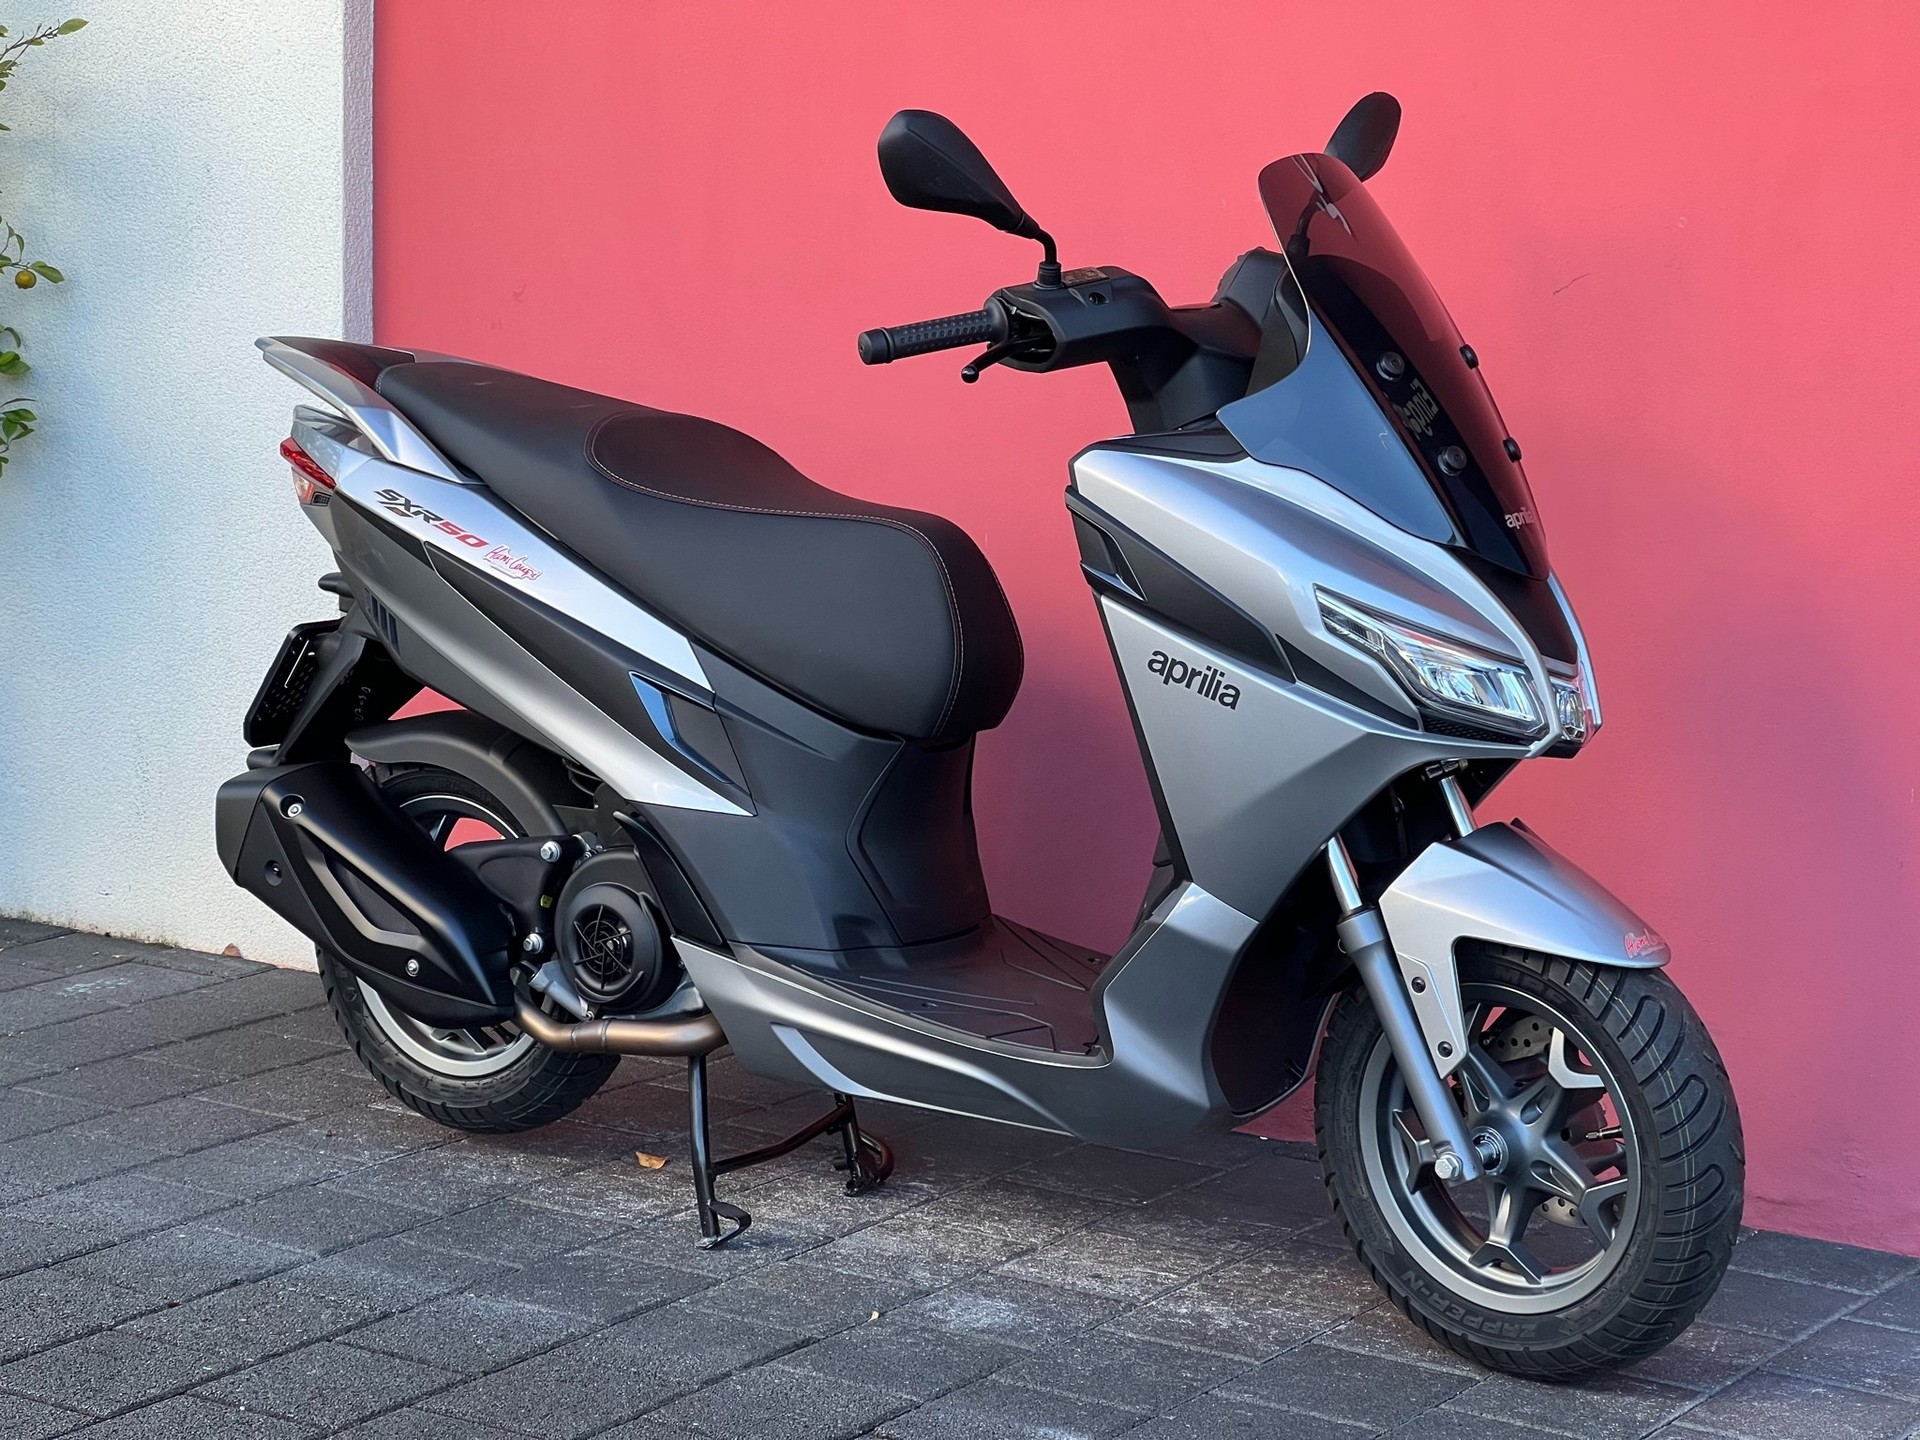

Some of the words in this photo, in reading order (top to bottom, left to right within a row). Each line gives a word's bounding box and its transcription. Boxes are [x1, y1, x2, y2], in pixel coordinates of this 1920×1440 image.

[374, 489, 489, 547] SXR50
[1147, 650, 1241, 710] aprilia
[1402, 1270, 1537, 1338] ZAPPER-N
